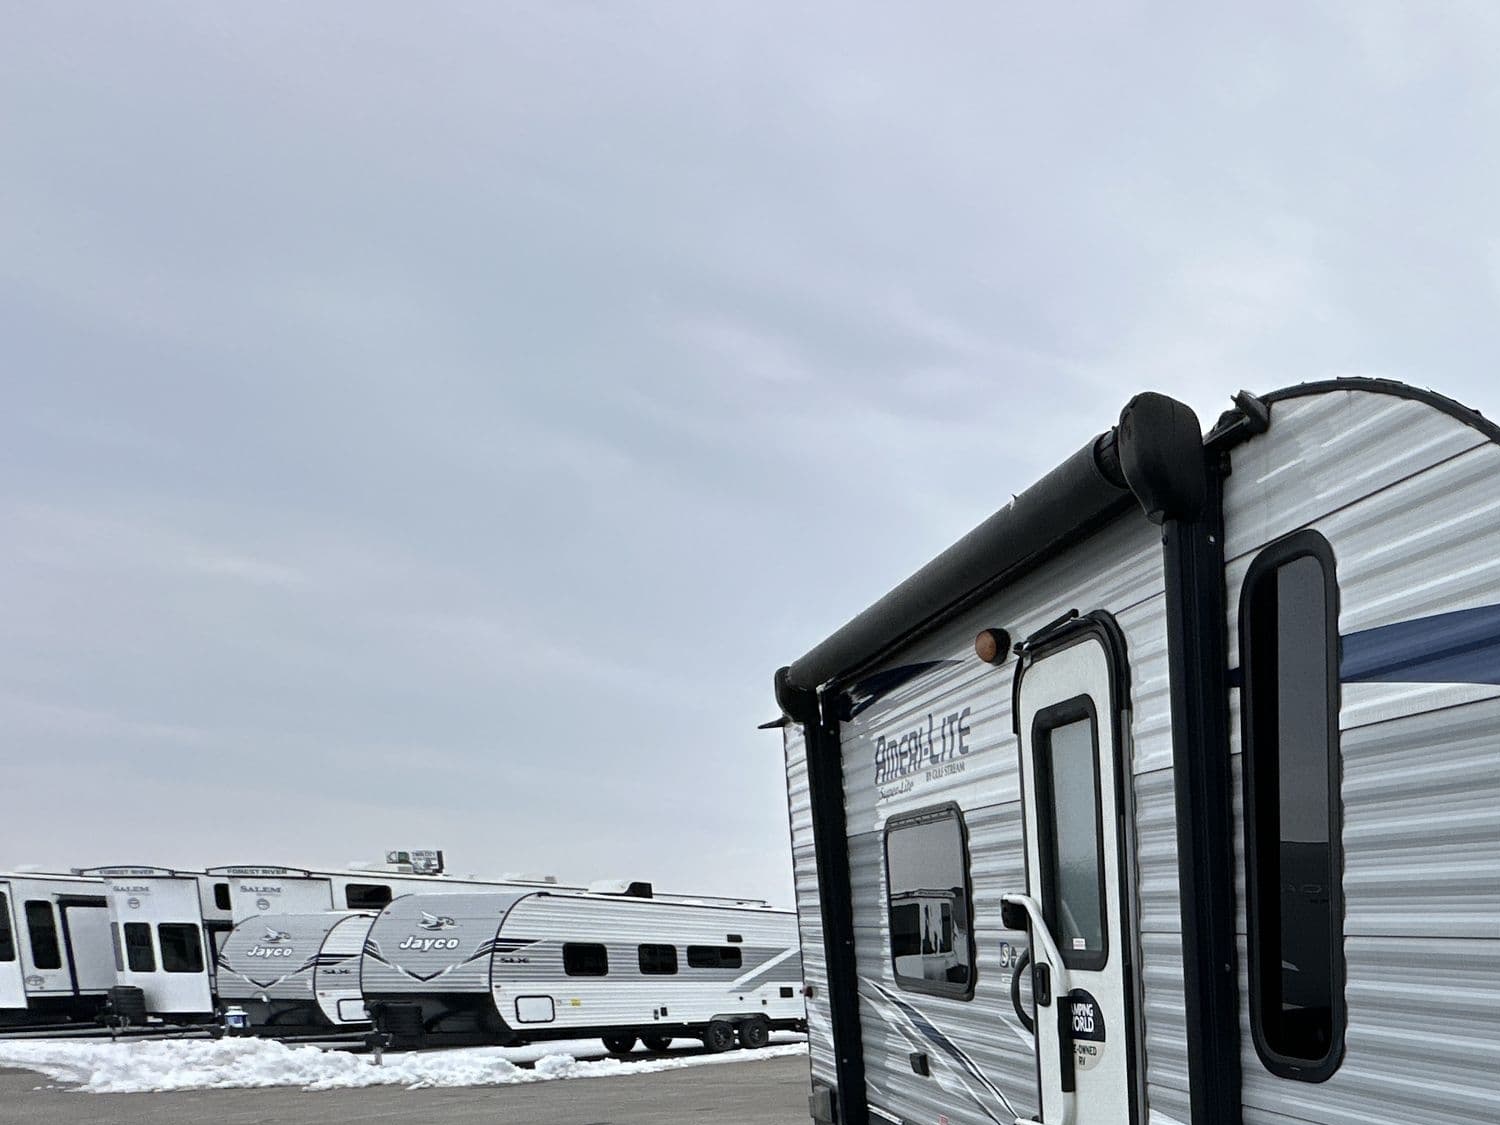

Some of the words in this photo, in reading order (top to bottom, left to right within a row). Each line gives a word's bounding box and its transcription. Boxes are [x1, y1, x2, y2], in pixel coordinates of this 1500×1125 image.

[240, 885, 282, 893] SALEM
[399, 935, 459, 952] Jayco
[247, 945, 293, 958] Jayco
